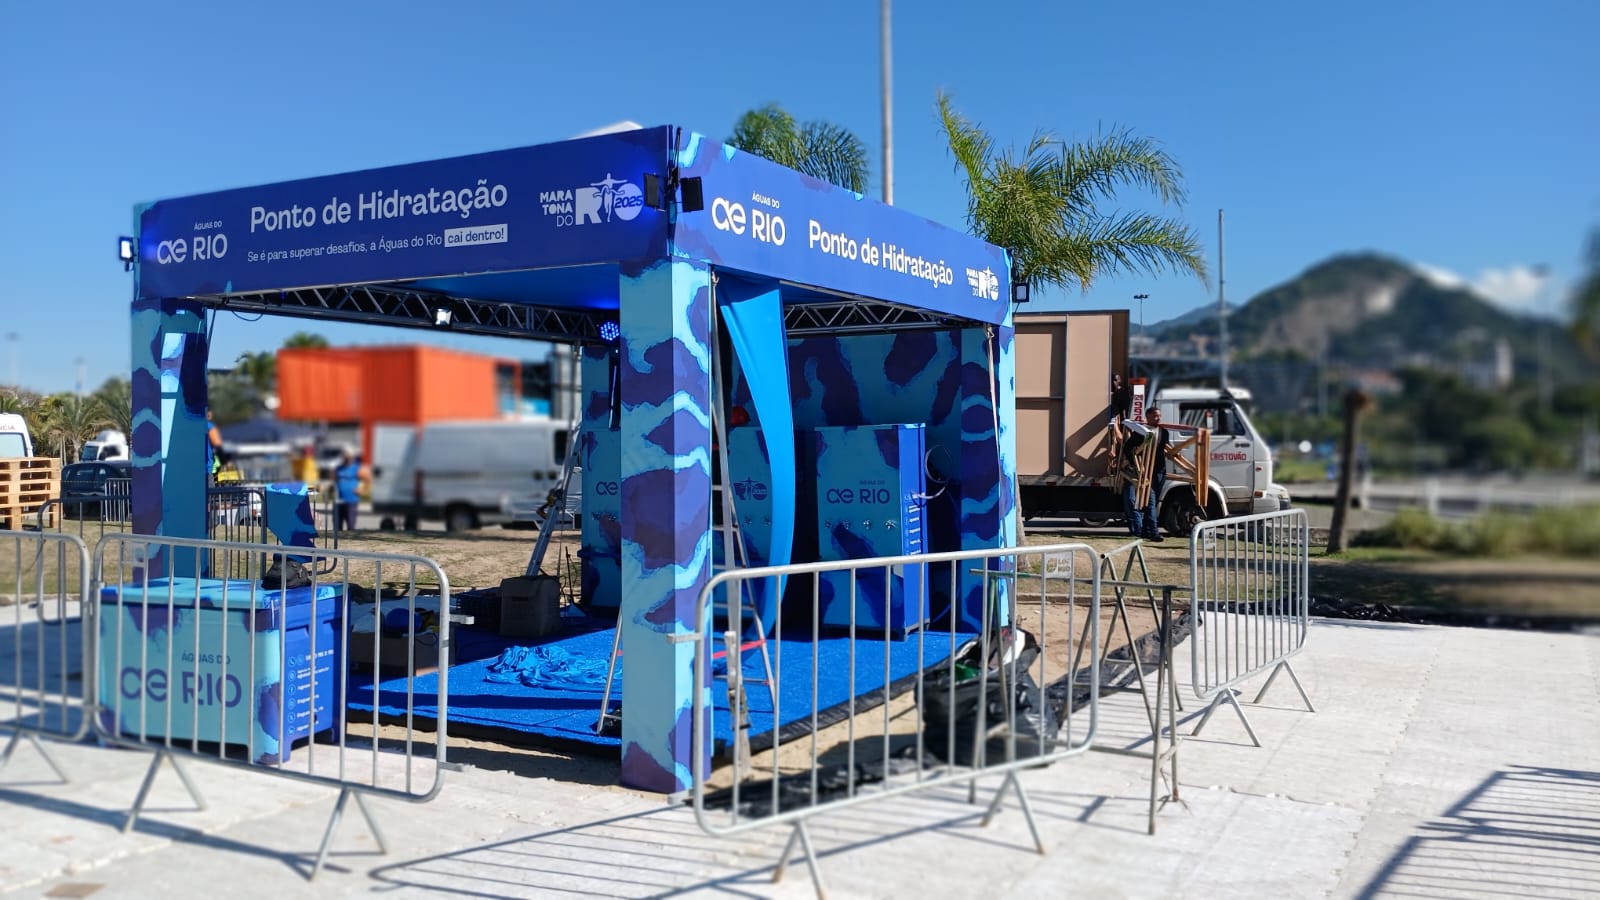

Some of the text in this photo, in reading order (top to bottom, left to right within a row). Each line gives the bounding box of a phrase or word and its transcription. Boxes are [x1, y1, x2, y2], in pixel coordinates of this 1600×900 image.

[540, 189, 574, 203] MARA
[614, 195, 643, 209] 2025
[771, 198, 780, 209] DO
[250, 178, 508, 233] Ponto de Hidratação
[542, 202, 573, 216] TONA
[213, 220, 223, 228] DO
[556, 215, 574, 227] DO
[751, 208, 786, 246] RIO
[193, 233, 228, 261] RIO
[247, 227, 504, 264] Se é para superar desafios, a Águas do Rio cai dentro!
[808, 219, 953, 289] Ponto de Hidratação
[859, 488, 890, 504] RIO
[181, 671, 242, 708] RIO
